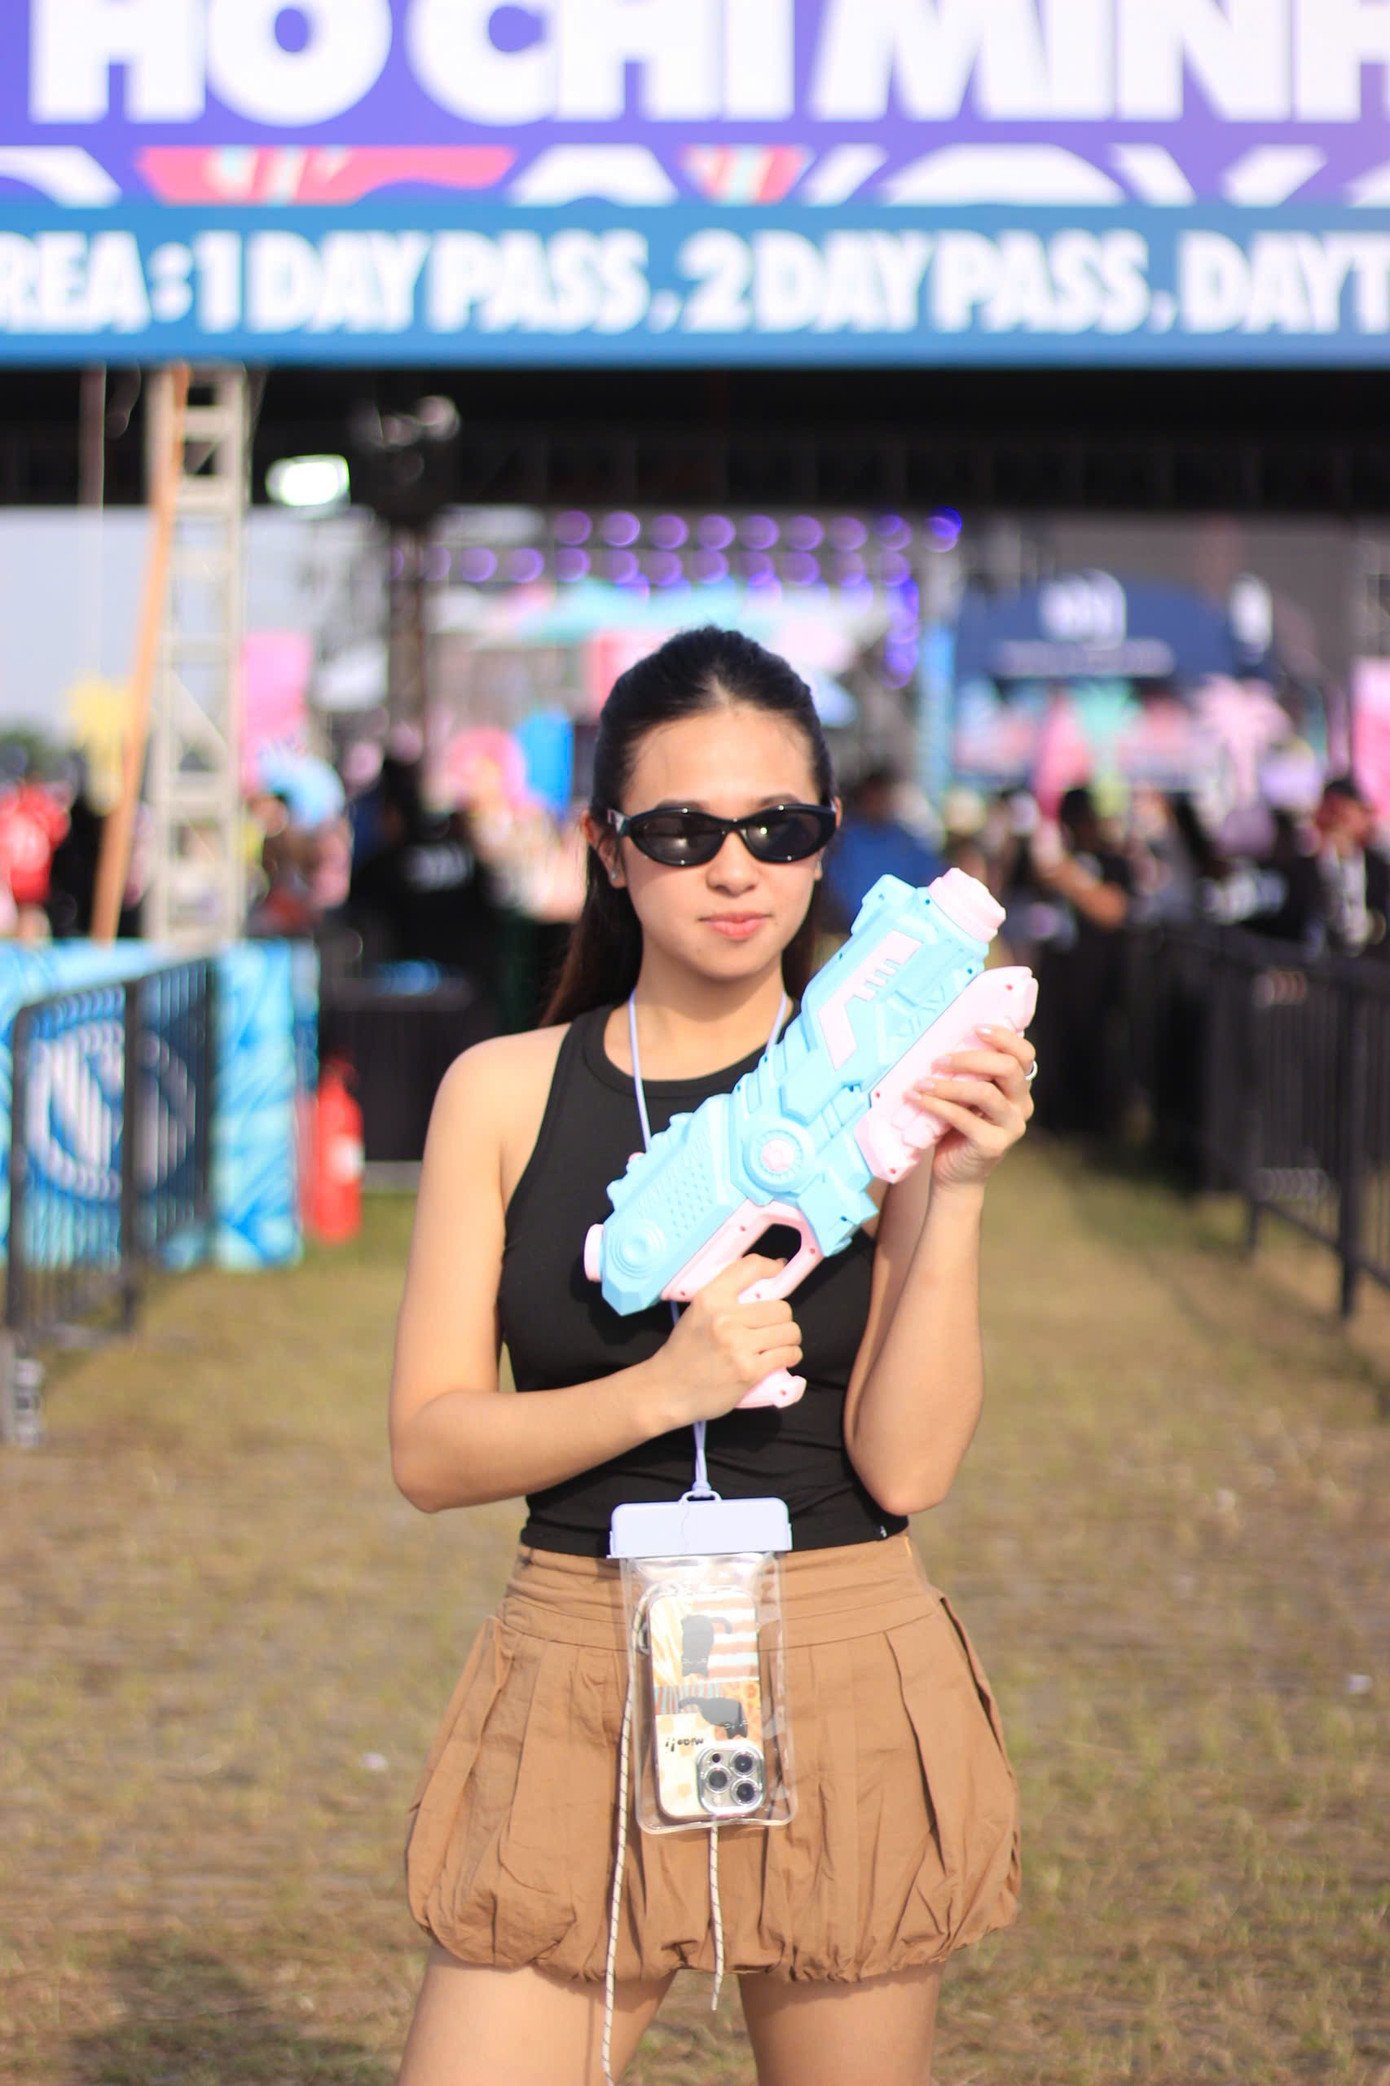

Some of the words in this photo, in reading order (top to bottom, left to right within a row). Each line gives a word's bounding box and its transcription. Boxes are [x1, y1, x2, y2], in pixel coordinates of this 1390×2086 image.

[28, 0, 392, 126] HO
[406, 0, 796, 126] CHI
[194, 229, 242, 334] 1
[245, 229, 431, 334] DAY
[676, 229, 753, 334] 2
[752, 229, 935, 334] DAY
